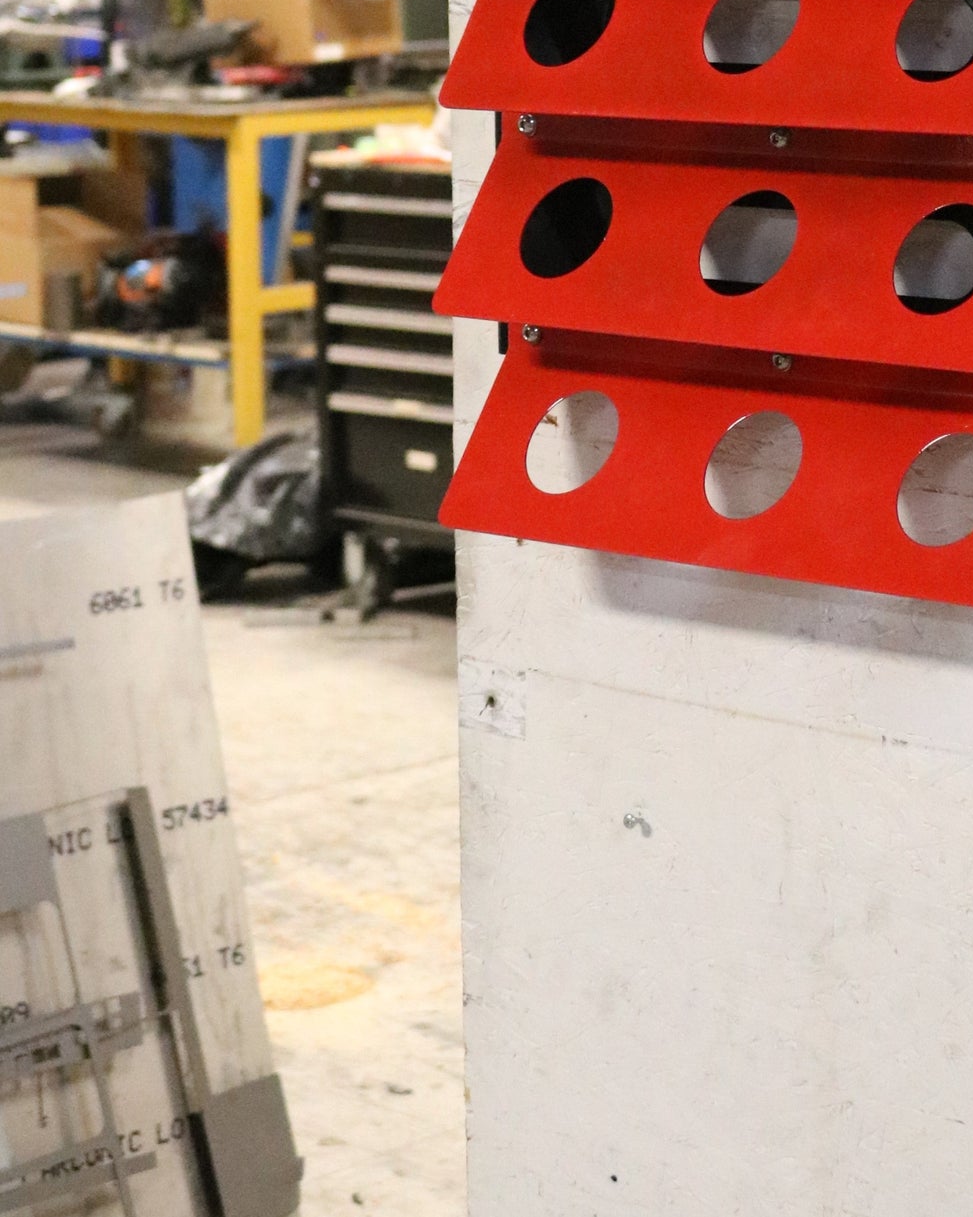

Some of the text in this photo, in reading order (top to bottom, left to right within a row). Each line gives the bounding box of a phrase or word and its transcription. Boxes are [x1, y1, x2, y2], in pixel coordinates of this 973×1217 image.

[158, 578, 185, 603] T6
[162, 797, 228, 830] 57434
[216, 943, 246, 970] T6
